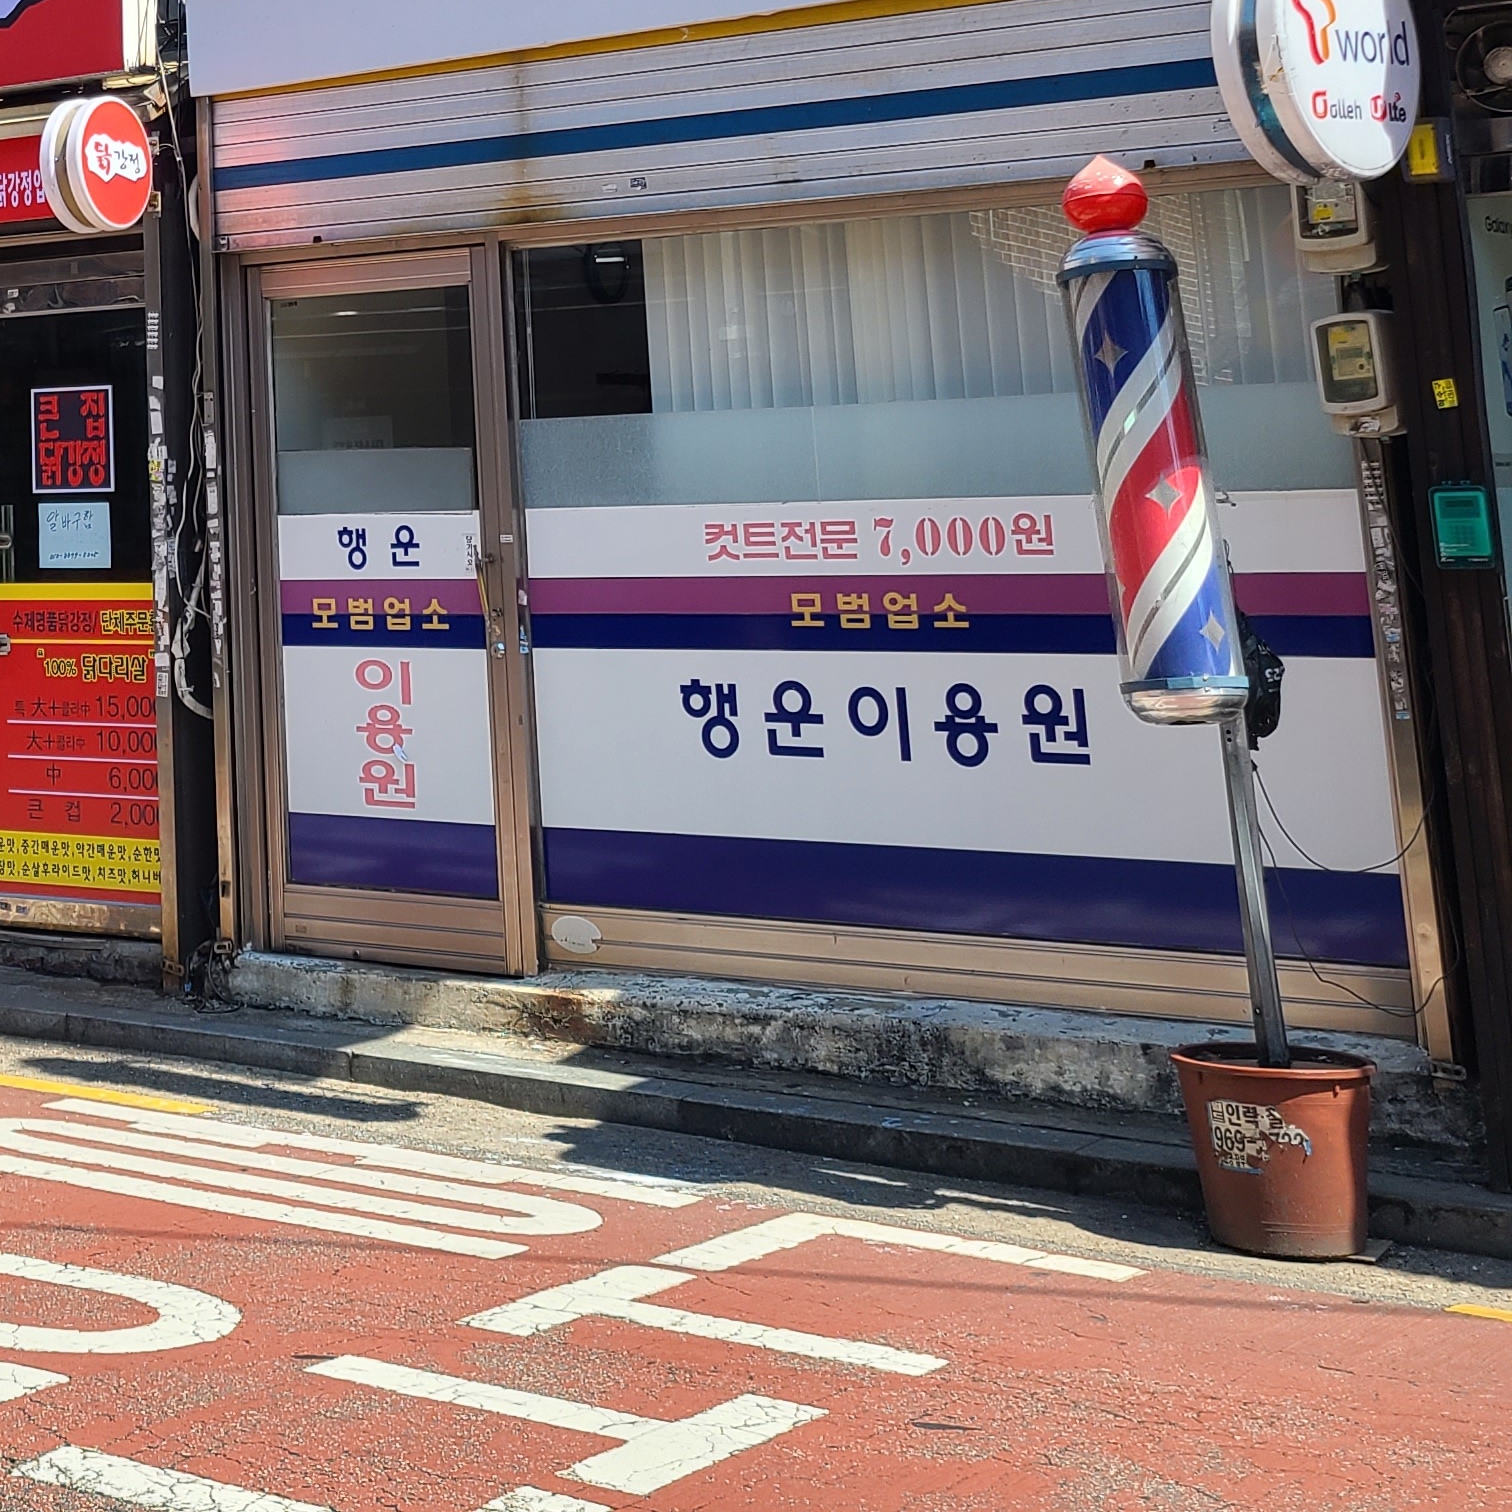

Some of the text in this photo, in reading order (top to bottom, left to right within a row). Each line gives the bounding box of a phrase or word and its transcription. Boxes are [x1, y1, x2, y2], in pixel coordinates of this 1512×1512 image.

[1335, 20, 1409, 66] world
[94, 141, 140, 175] 닭강정
[702, 512, 1057, 567] 컷트전문 7,000원
[311, 596, 450, 631] 모범업소
[789, 589, 970, 631] 모범업소
[96, 695, 156, 720] 15,00
[679, 677, 1092, 768] 행운이용원
[96, 729, 157, 755] 10,00
[46, 763, 158, 792] 中 6,00
[110, 802, 159, 828] 2,00
